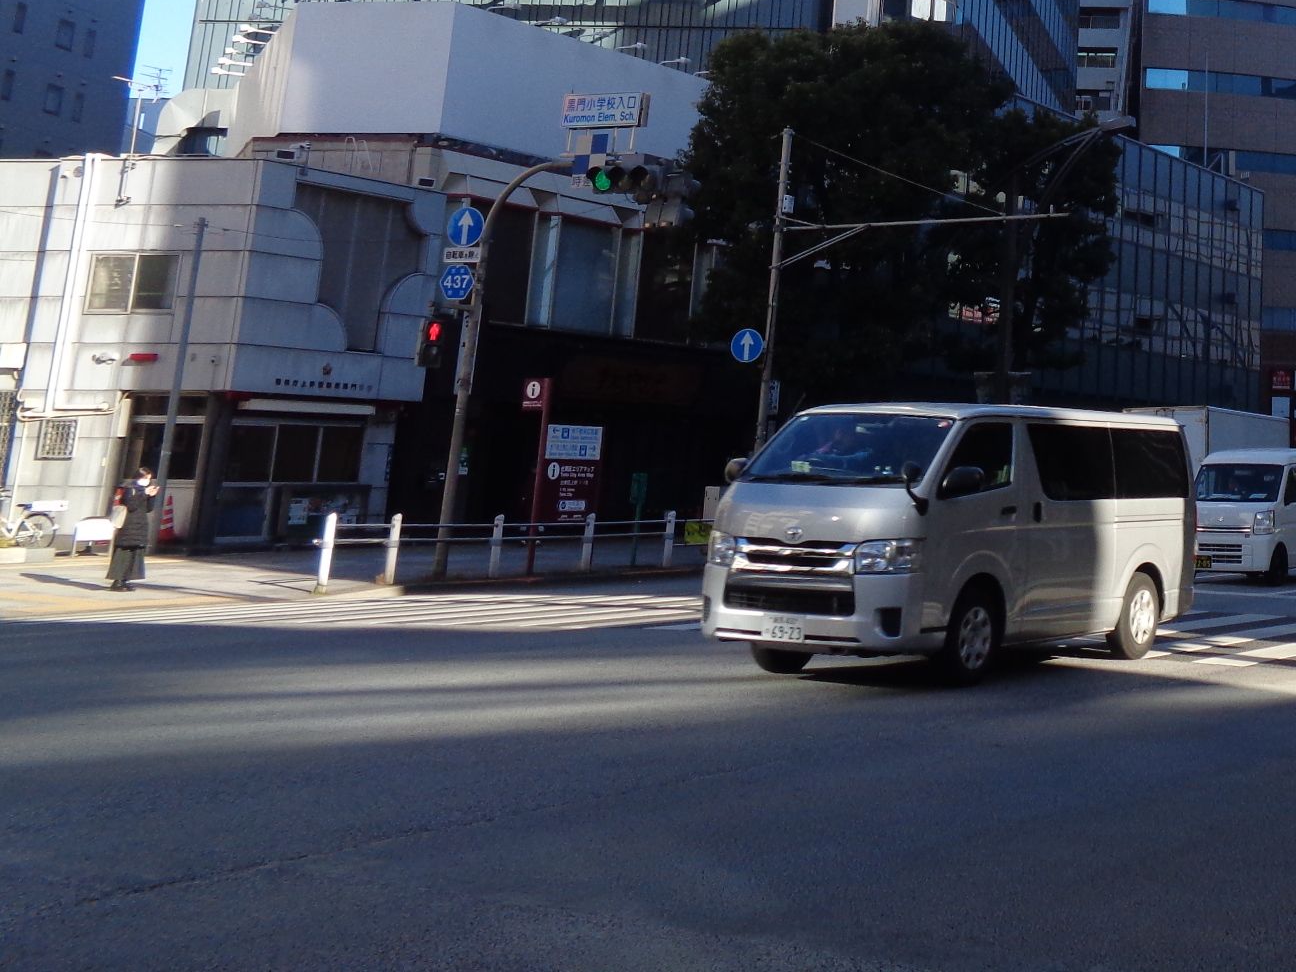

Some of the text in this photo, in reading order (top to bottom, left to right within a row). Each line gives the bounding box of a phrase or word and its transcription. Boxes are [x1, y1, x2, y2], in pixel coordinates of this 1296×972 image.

[566, 96, 637, 112] 黒門小学校入口
[563, 114, 596, 124] Kuromon
[619, 111, 635, 121] Sch.
[443, 275, 470, 288] 437
[770, 625, 802, 641] 69-23
